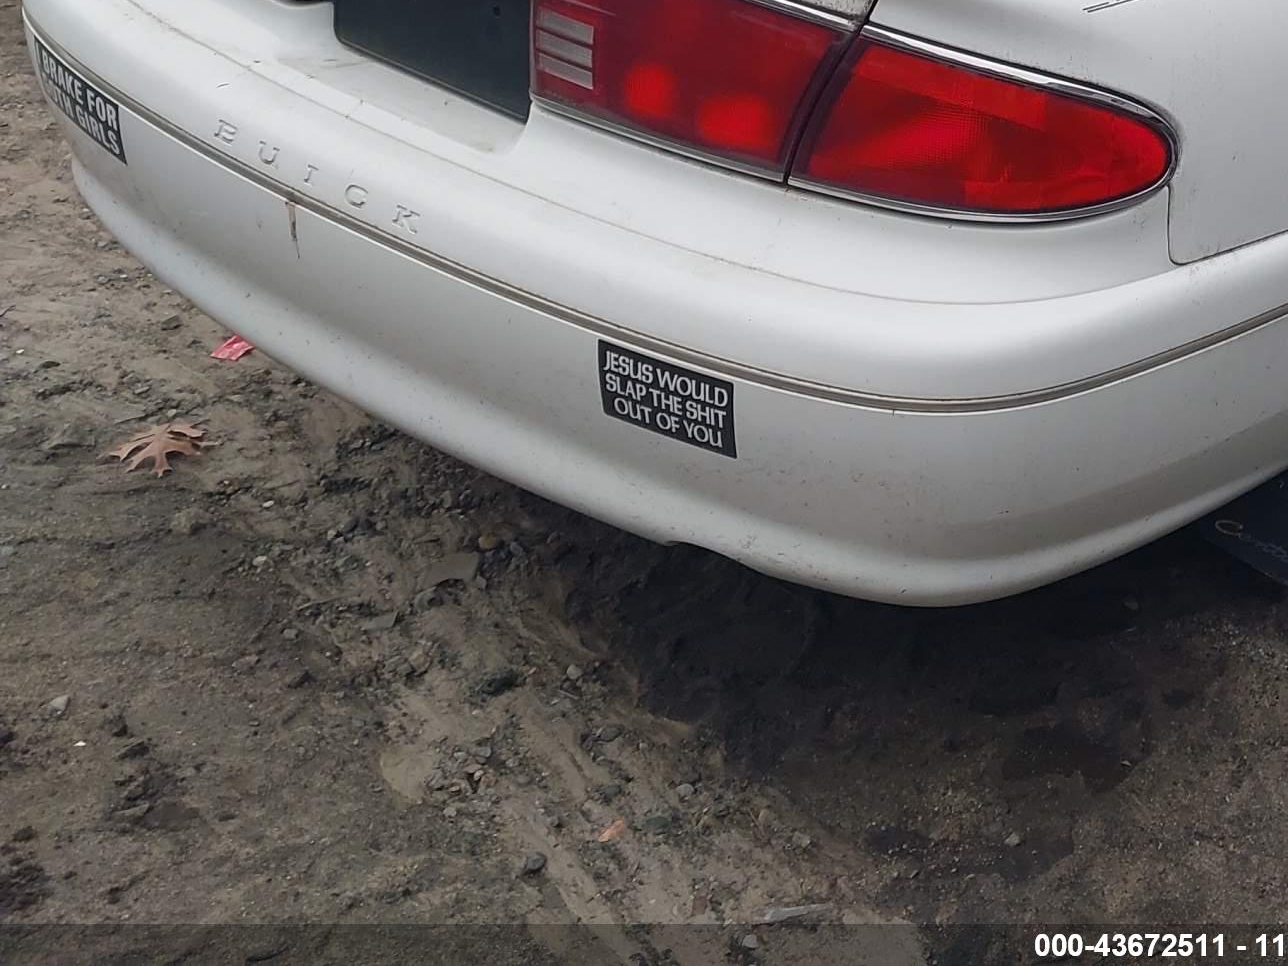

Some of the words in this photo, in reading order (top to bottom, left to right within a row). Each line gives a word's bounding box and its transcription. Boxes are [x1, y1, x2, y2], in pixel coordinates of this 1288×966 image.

[42, 49, 84, 105] BRAKE
[86, 88, 118, 131] FOR
[76, 104, 120, 155] GIRLS
[213, 118, 421, 235] BUICK
[603, 350, 653, 384] JESUS
[656, 368, 728, 407] WOULD
[605, 372, 646, 401] SLAP
[649, 388, 682, 415] THE
[685, 400, 726, 428] SHIT
[614, 397, 652, 424] OUT
[656, 412, 680, 433] OF
[683, 419, 722, 448] YOU
